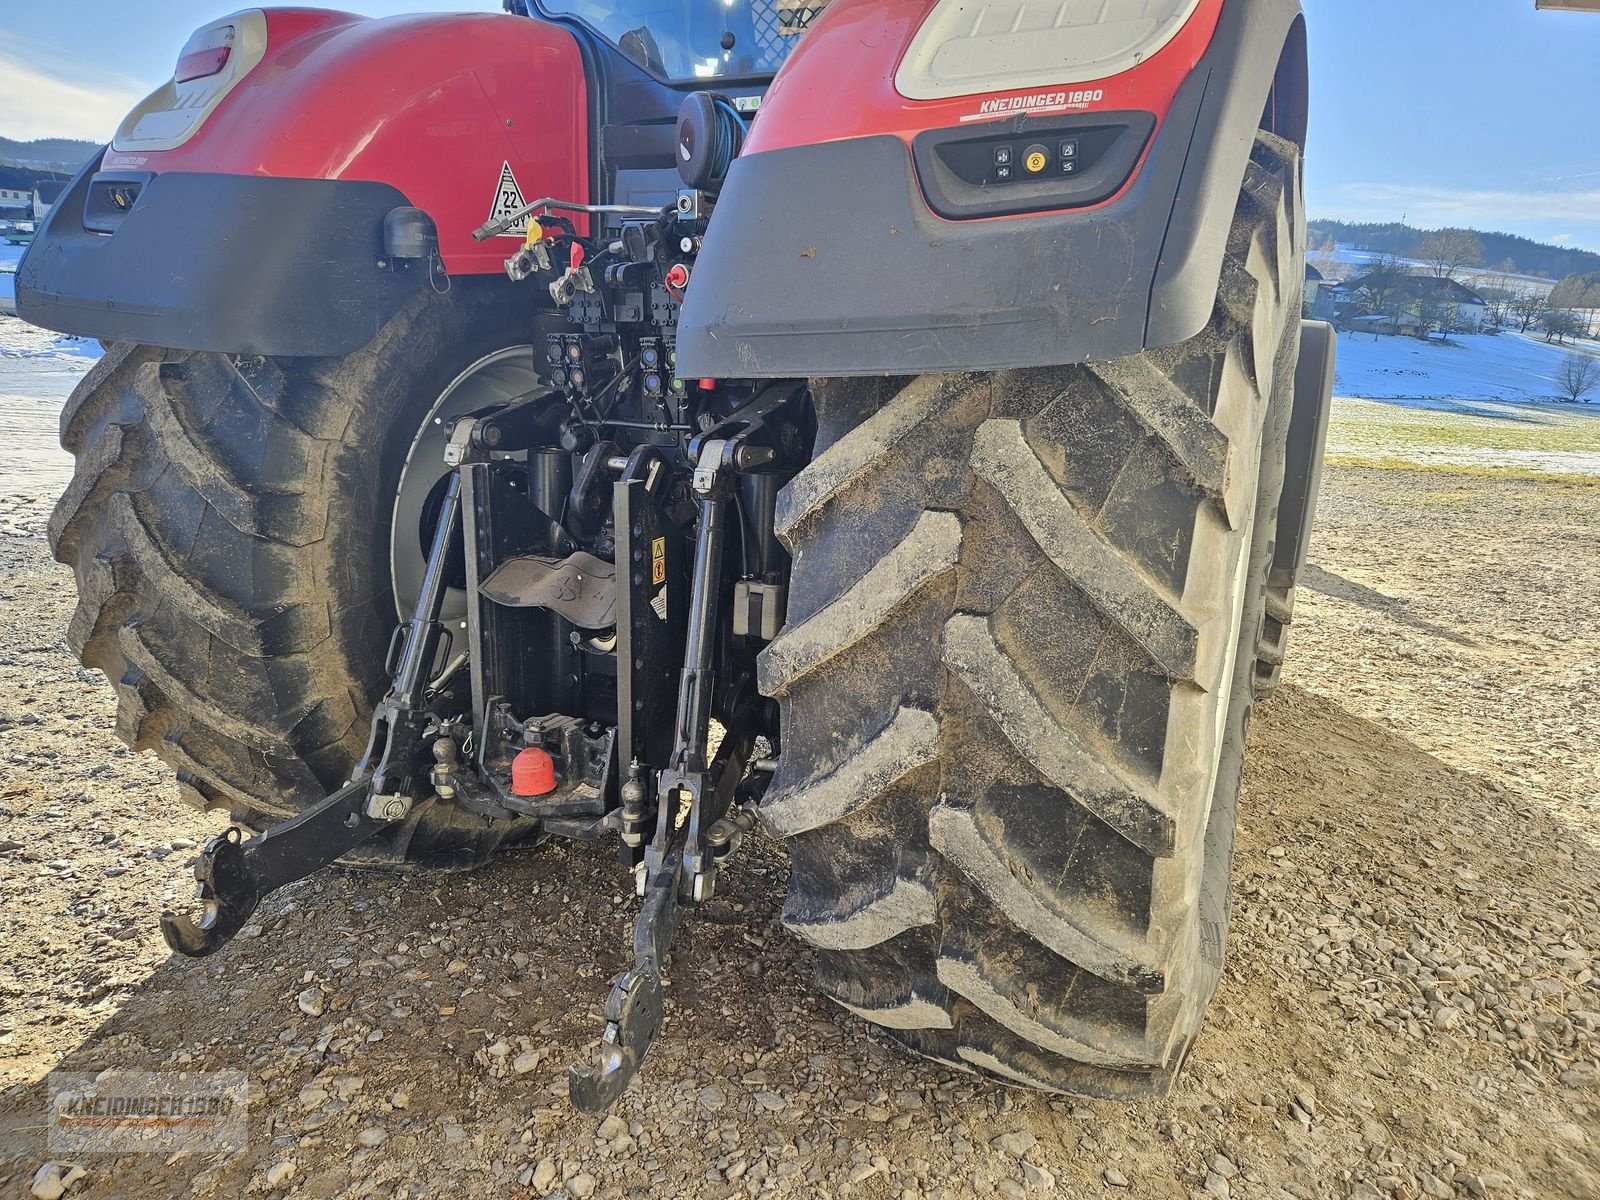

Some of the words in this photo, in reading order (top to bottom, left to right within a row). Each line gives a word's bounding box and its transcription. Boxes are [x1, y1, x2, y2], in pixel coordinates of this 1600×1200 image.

[980, 92, 1066, 113] KNEIDINGER
[1068, 89, 1103, 103] 1880
[503, 191, 518, 209] 22
